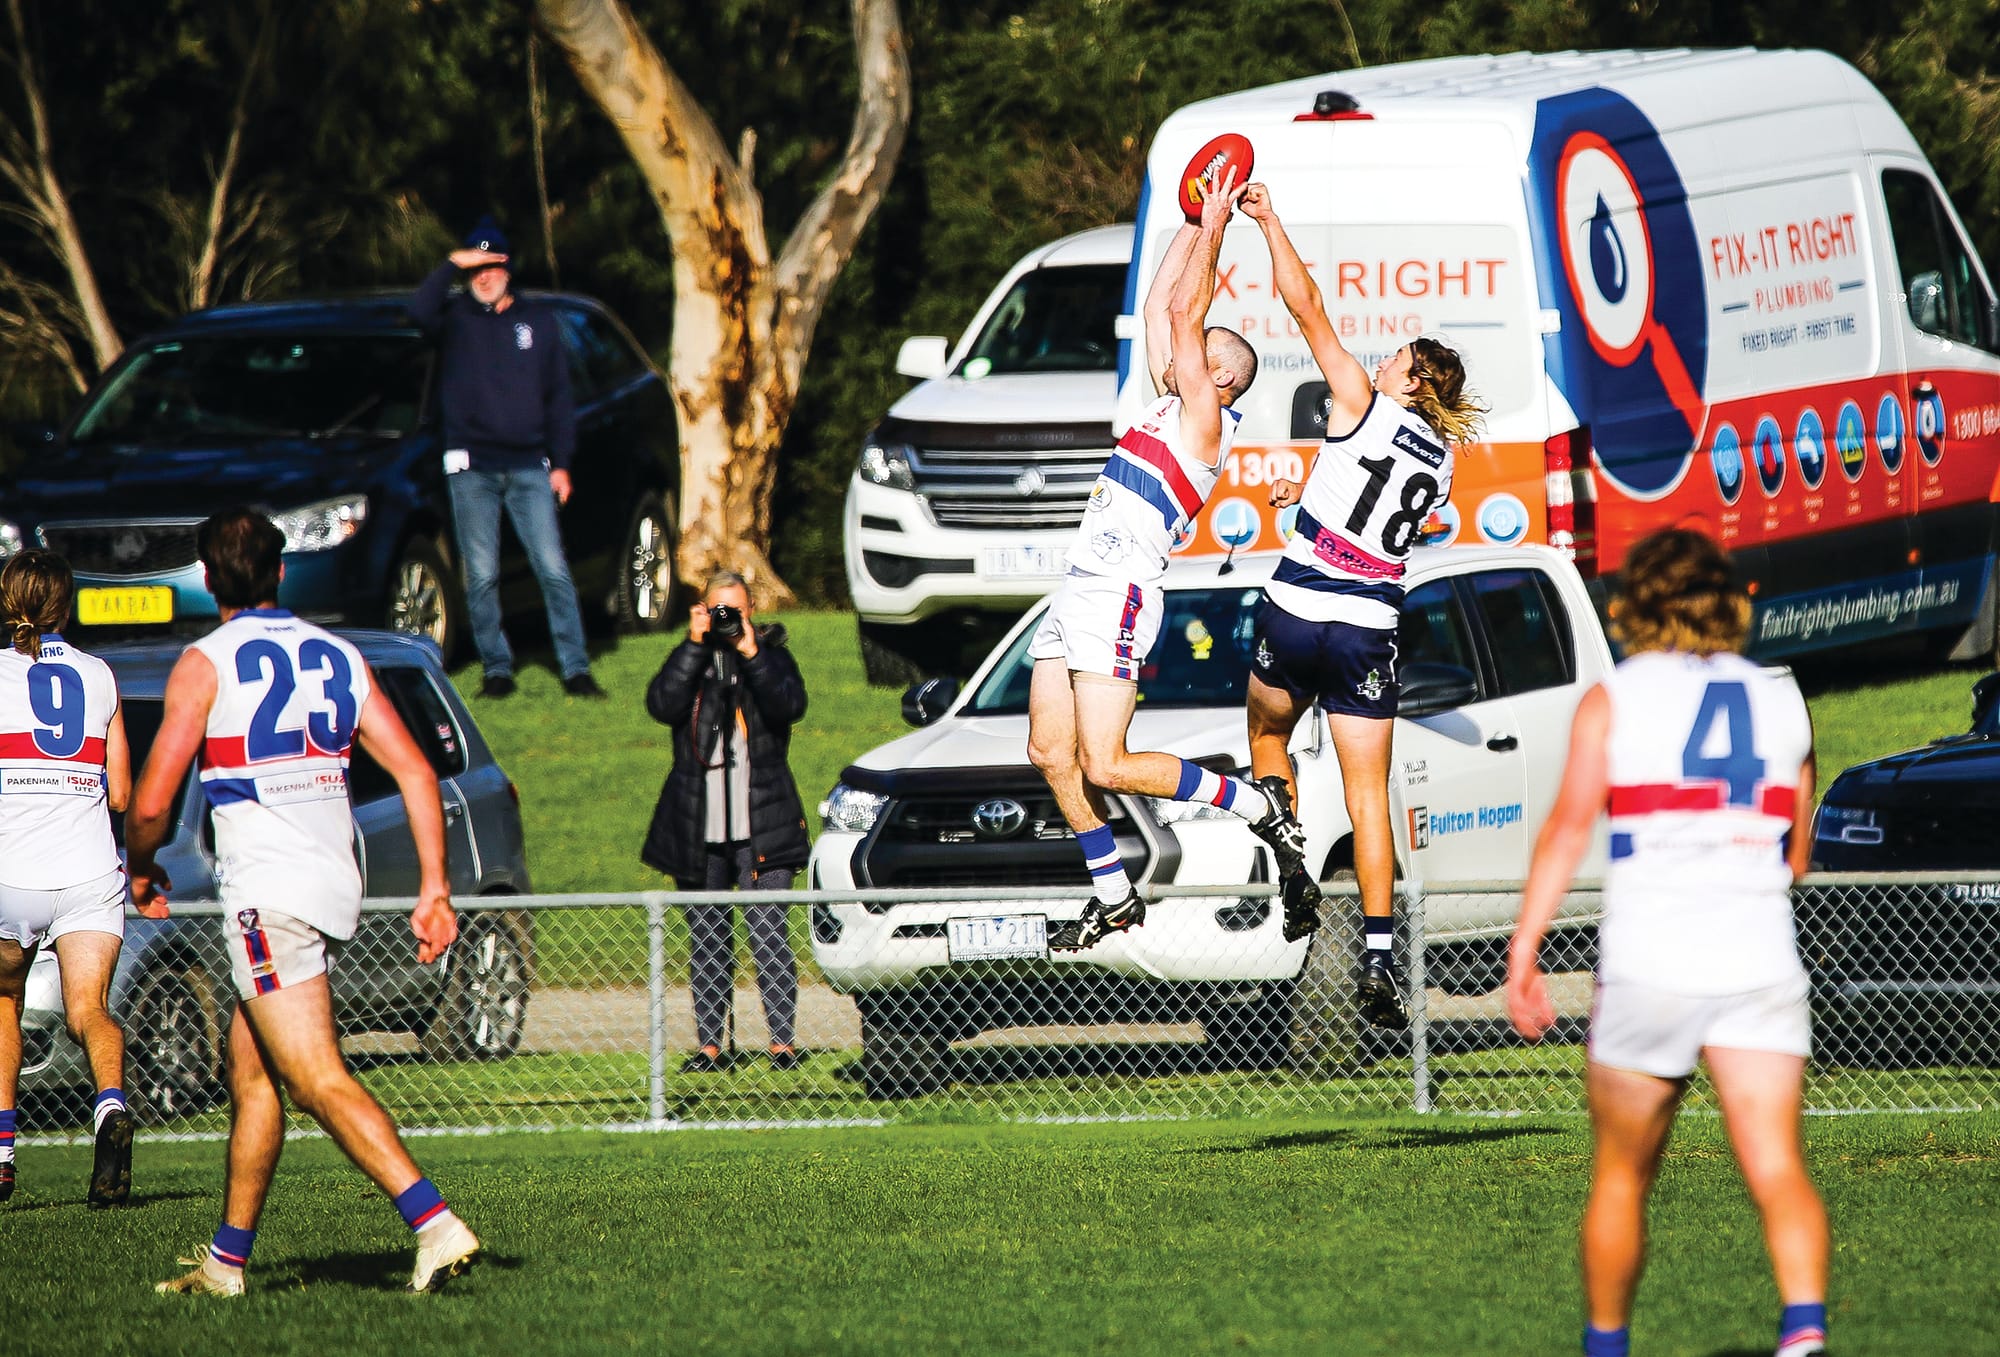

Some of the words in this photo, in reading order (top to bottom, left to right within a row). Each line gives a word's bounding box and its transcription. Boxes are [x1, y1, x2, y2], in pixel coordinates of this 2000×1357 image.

[1711, 227, 1780, 281] FIX-IT
[1787, 213, 1857, 266] RIGHT
[1338, 260, 1508, 299] RIGHT
[1755, 277, 1834, 314] PLUMBING
[1240, 313, 1424, 339] PLUBING
[1741, 331, 1769, 353] FIXED
[1262, 352, 1314, 371] RIGH
[1953, 408, 1981, 441] 1300
[1217, 451, 1304, 488] 1300
[1344, 455, 1439, 557] 18
[1761, 579, 1960, 642] fixitrightplumbing.com.au
[27, 663, 85, 757] 9
[234, 639, 358, 761] 23
[1683, 682, 1765, 806] 4
[7, 778, 59, 786] PAKENHAM
[67, 776, 99, 788] ISUZU
[1429, 810, 1474, 837] Fulton
[1478, 802, 1523, 829] Hogan
